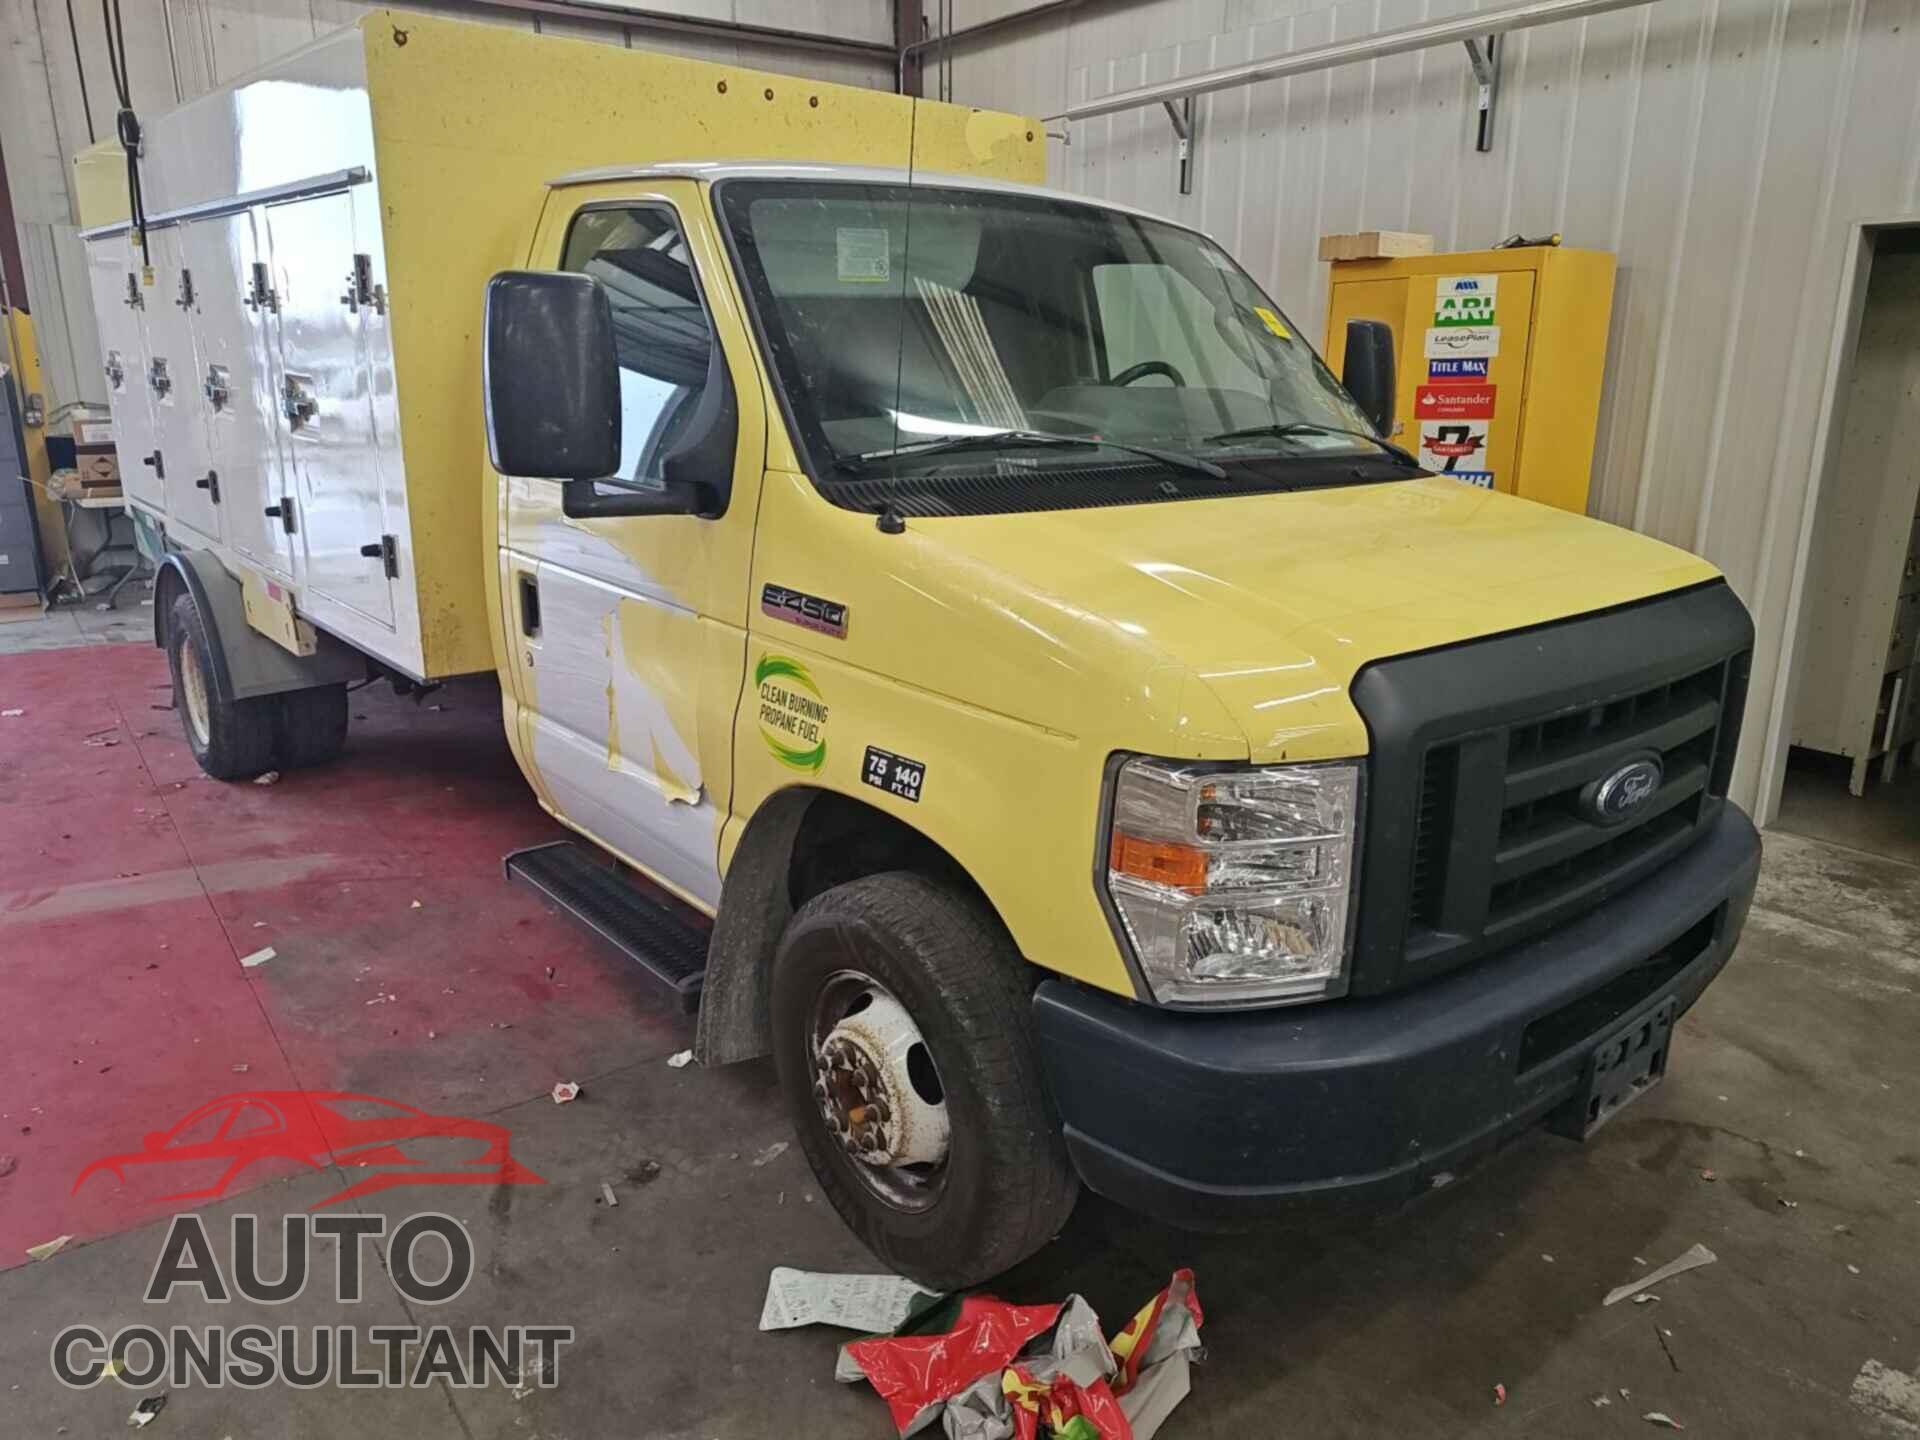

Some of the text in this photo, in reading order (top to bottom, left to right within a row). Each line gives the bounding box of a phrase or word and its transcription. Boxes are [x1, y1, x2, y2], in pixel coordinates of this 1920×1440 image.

[1437, 297, 1493, 322] ARI
[1431, 360, 1487, 374] TITLE MAX
[1437, 393, 1490, 405] Santander
[760, 682, 829, 724] CLEAN BURNING
[759, 703, 820, 744] PROPANE FUEL
[869, 755, 888, 775] 75
[895, 766, 921, 788] 140
[1618, 774, 1653, 809] Ford
